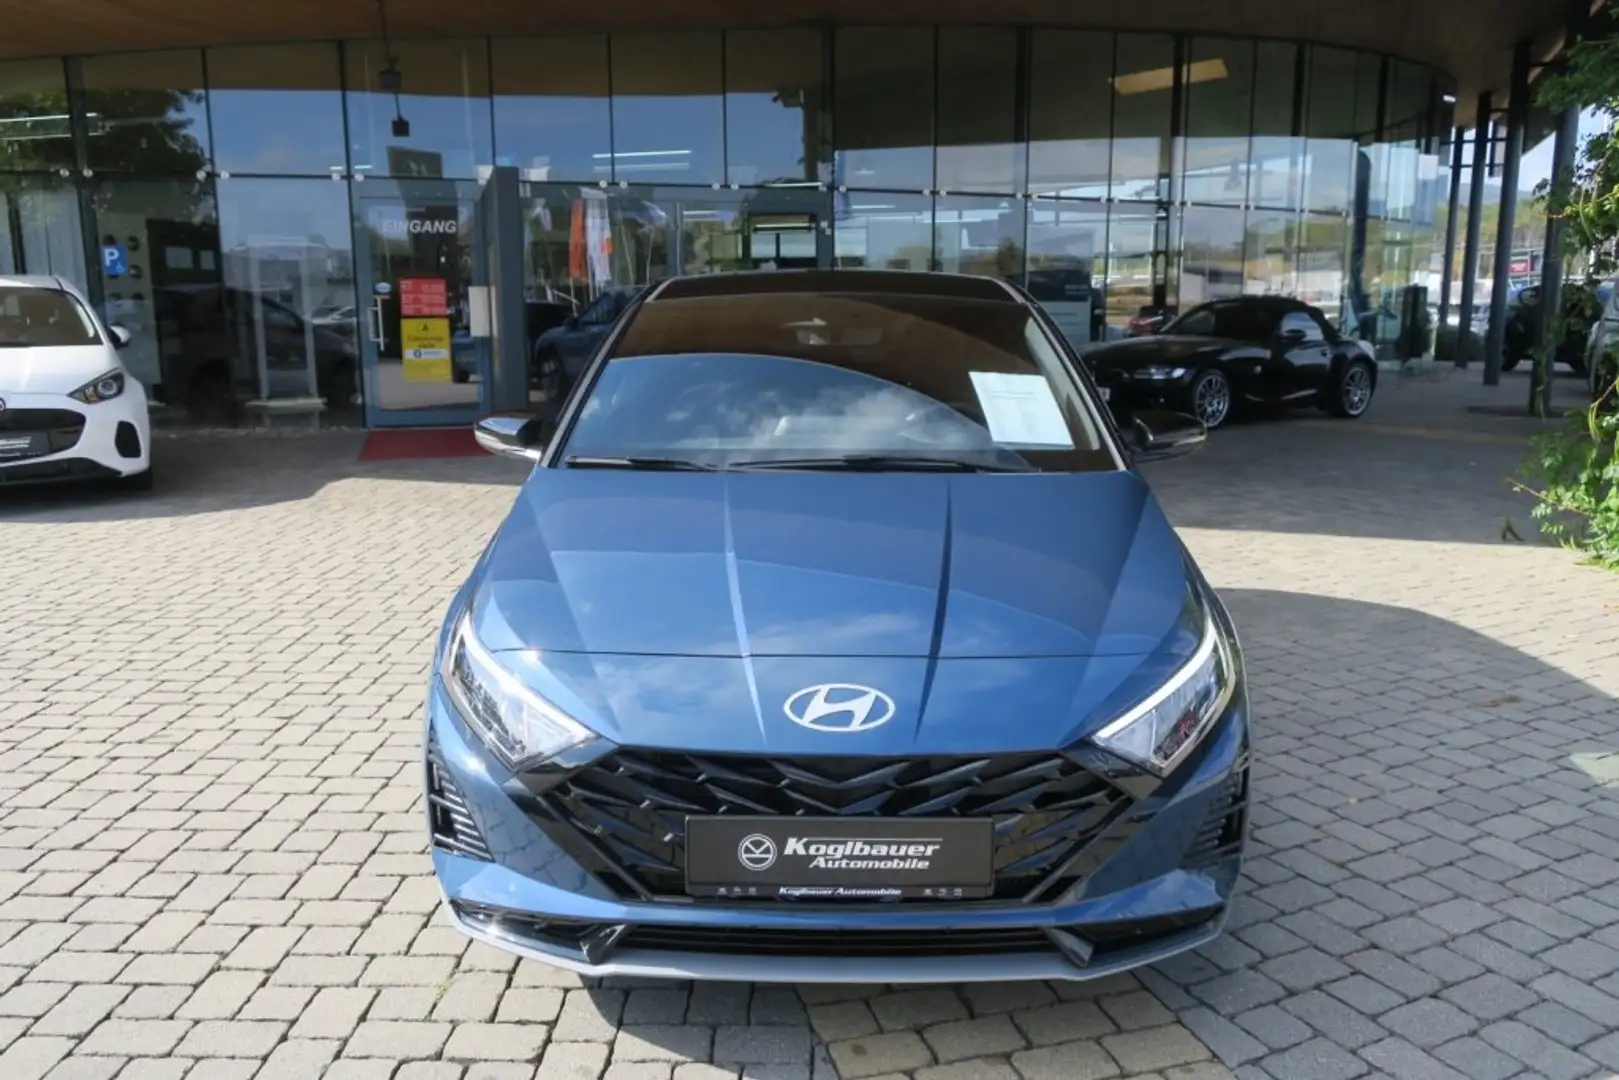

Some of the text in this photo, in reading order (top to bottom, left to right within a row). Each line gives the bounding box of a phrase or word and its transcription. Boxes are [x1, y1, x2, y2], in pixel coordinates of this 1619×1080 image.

[381, 219, 457, 234] EINGANG
[105, 248, 119, 267] P
[783, 837, 941, 859] Koglbauer
[809, 857, 930, 870] Automobile
[778, 886, 902, 896] Koglbauer Automobile
